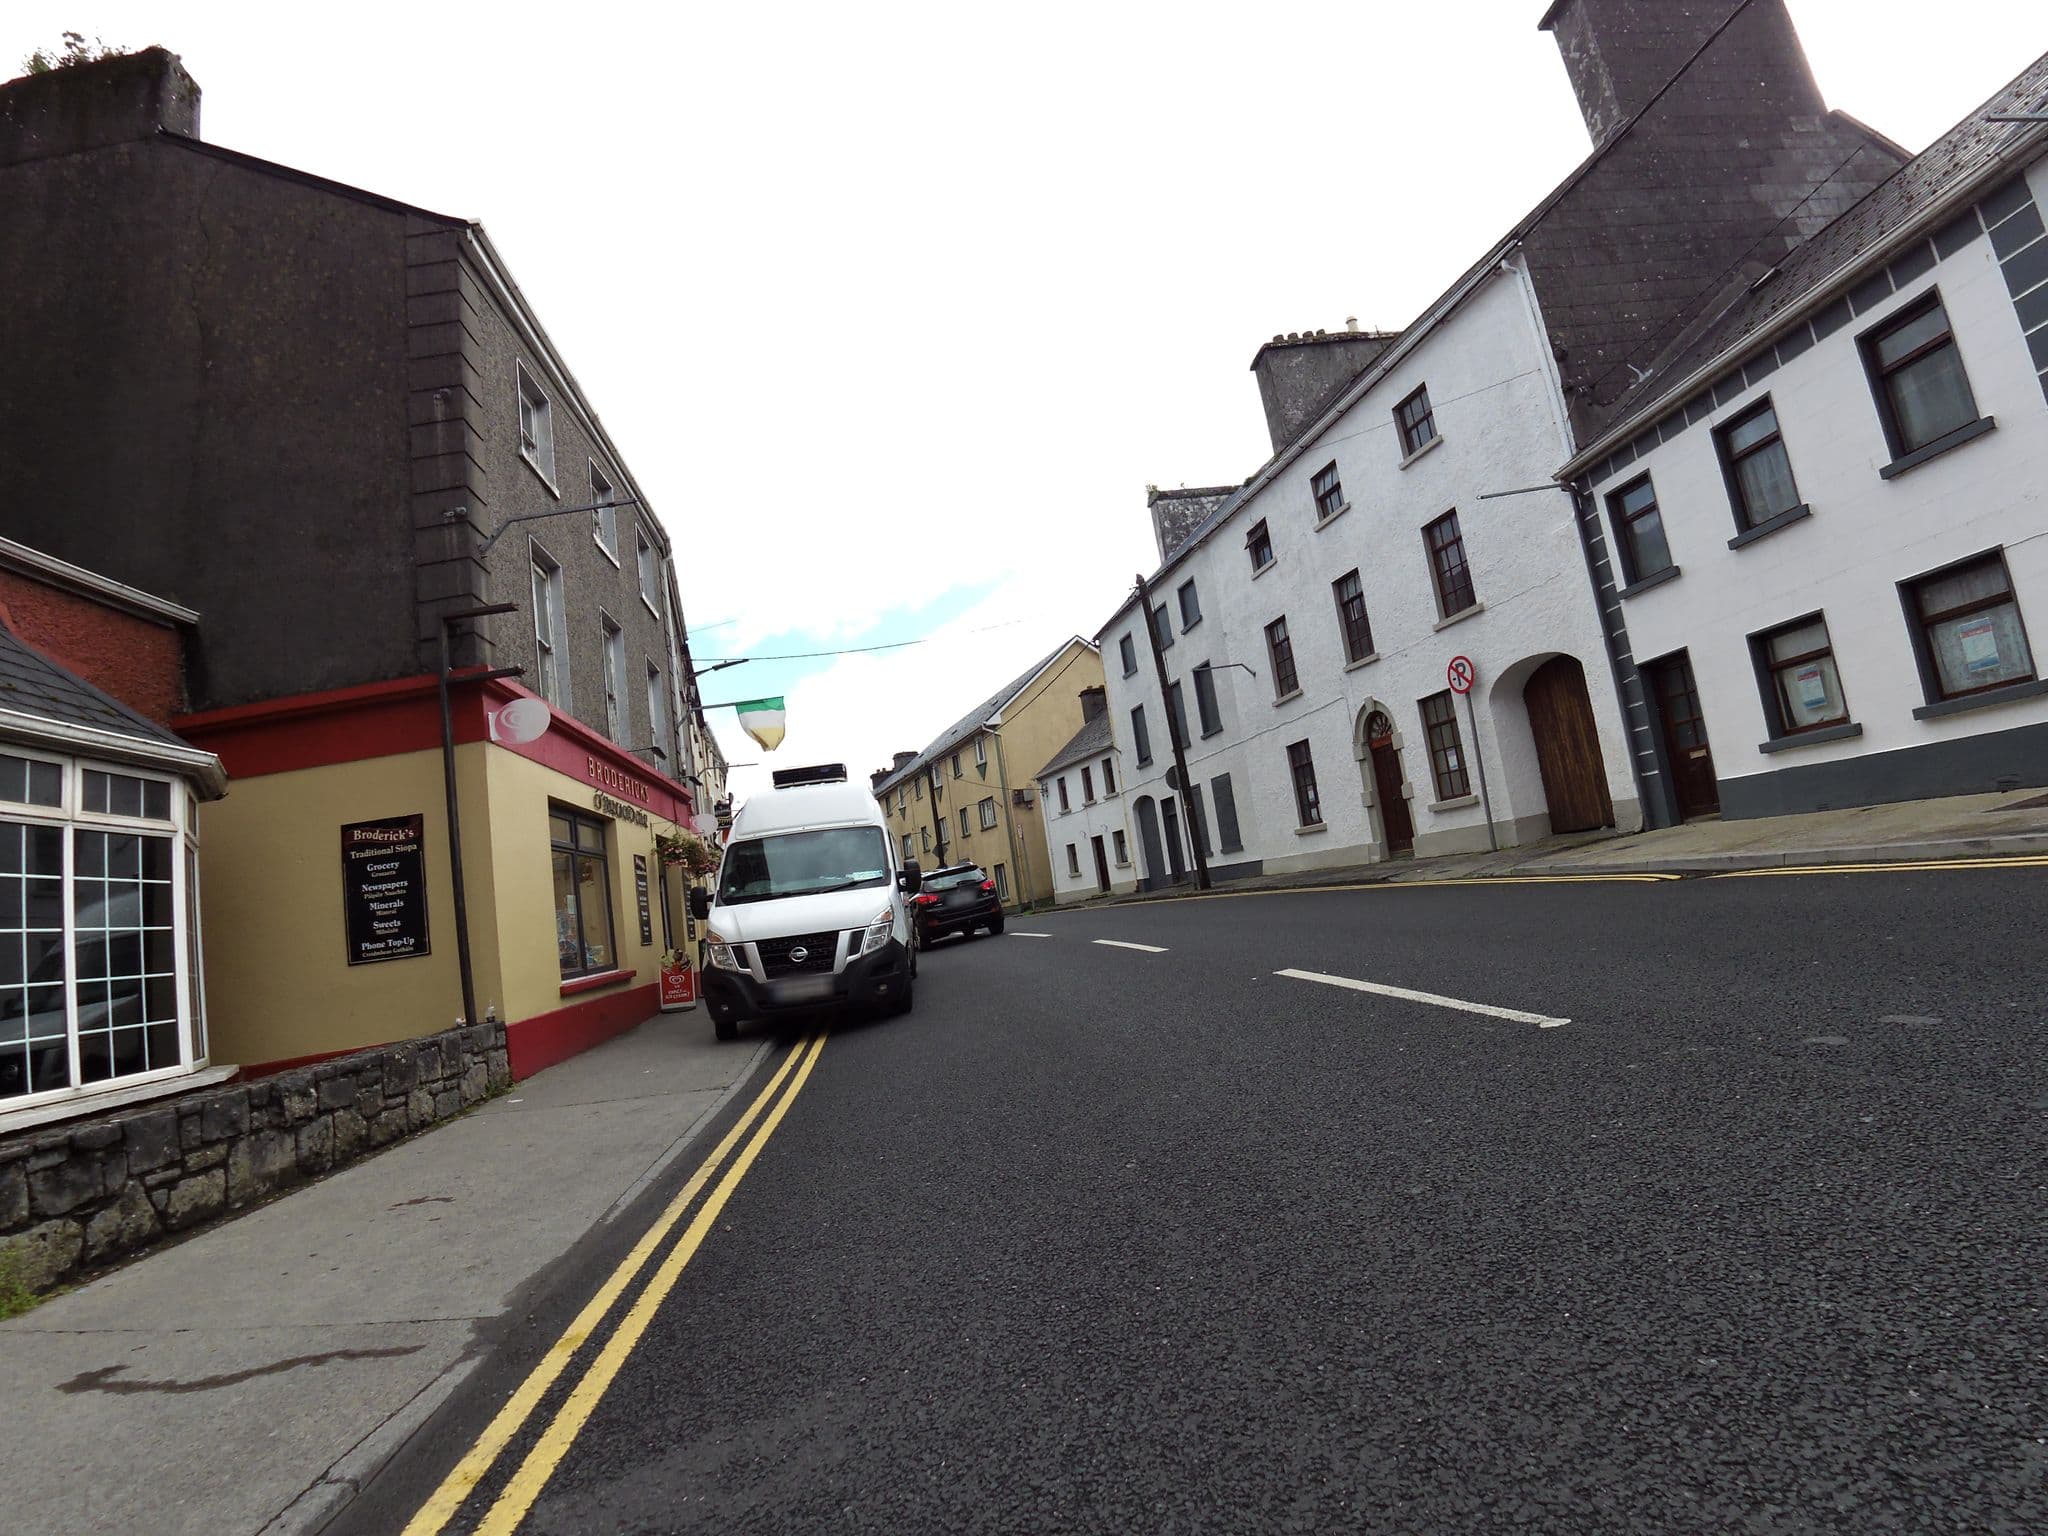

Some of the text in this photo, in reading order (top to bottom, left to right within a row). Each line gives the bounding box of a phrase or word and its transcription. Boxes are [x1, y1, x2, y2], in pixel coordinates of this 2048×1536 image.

[588, 756, 649, 803] BRODERICKS
[354, 829, 415, 841] Broderick's
[350, 845, 394, 859] Traditional
[366, 861, 400, 871] Grocery
[361, 880, 409, 892] Newspapers
[369, 899, 404, 911] Minerals
[372, 919, 402, 929] Sweets
[361, 936, 415, 951] Phone Top-Up
